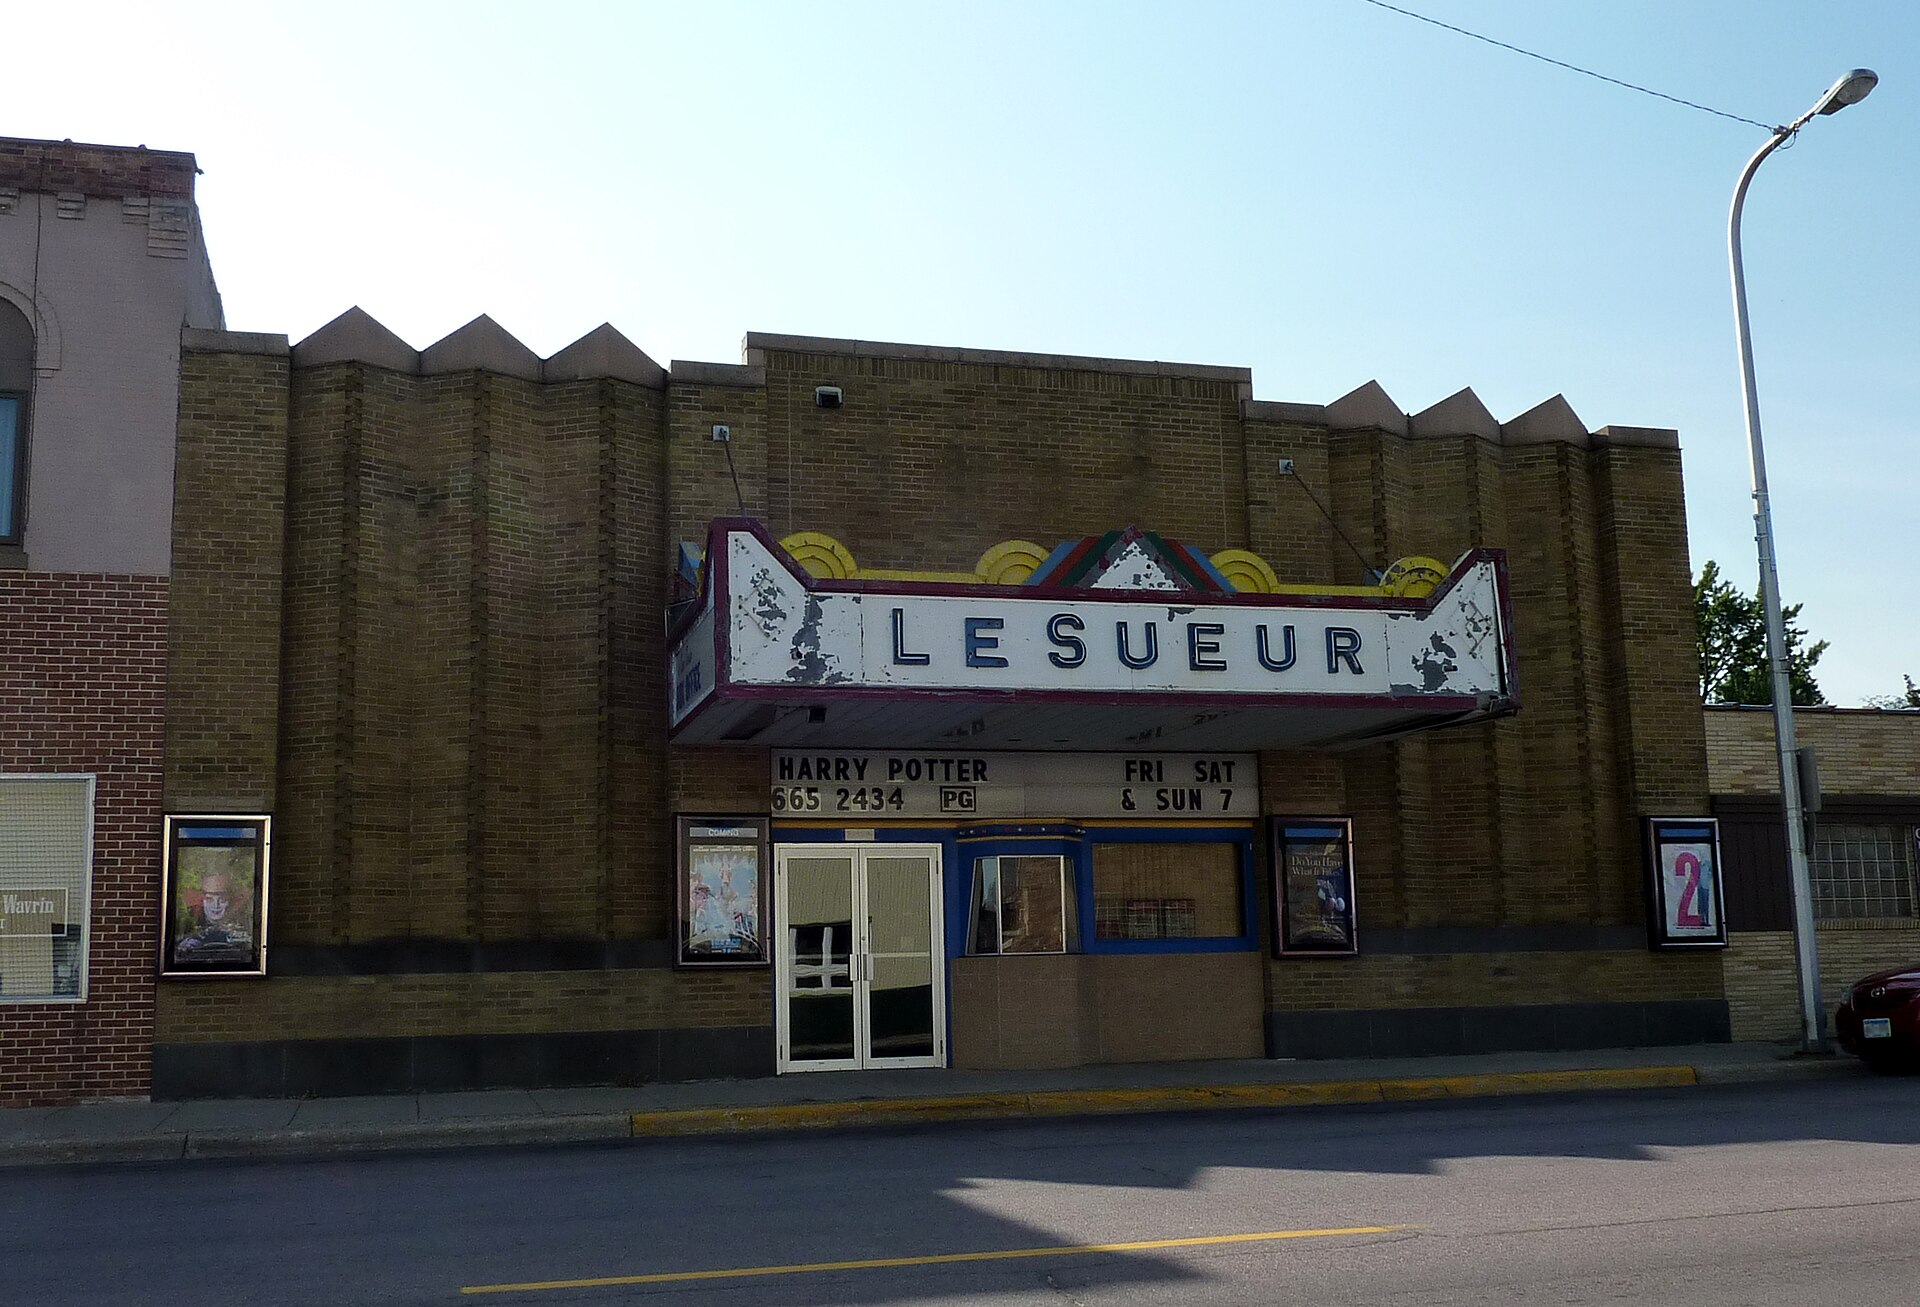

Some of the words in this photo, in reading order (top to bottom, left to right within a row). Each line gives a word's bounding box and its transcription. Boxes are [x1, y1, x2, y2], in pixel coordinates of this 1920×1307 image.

[779, 756, 869, 782] HARRY
[888, 758, 988, 783] POTTER
[1125, 759, 1163, 783] FRI
[1194, 760, 1236, 783] SAT
[771, 787, 820, 811] 665
[836, 787, 905, 812] 2434
[942, 790, 974, 809] PG
[1121, 788, 1136, 811] &
[1155, 788, 1202, 811] SUN
[1220, 789, 1233, 811] 7
[1675, 851, 1702, 927] 2
[2, 894, 54, 914] Wavrin
